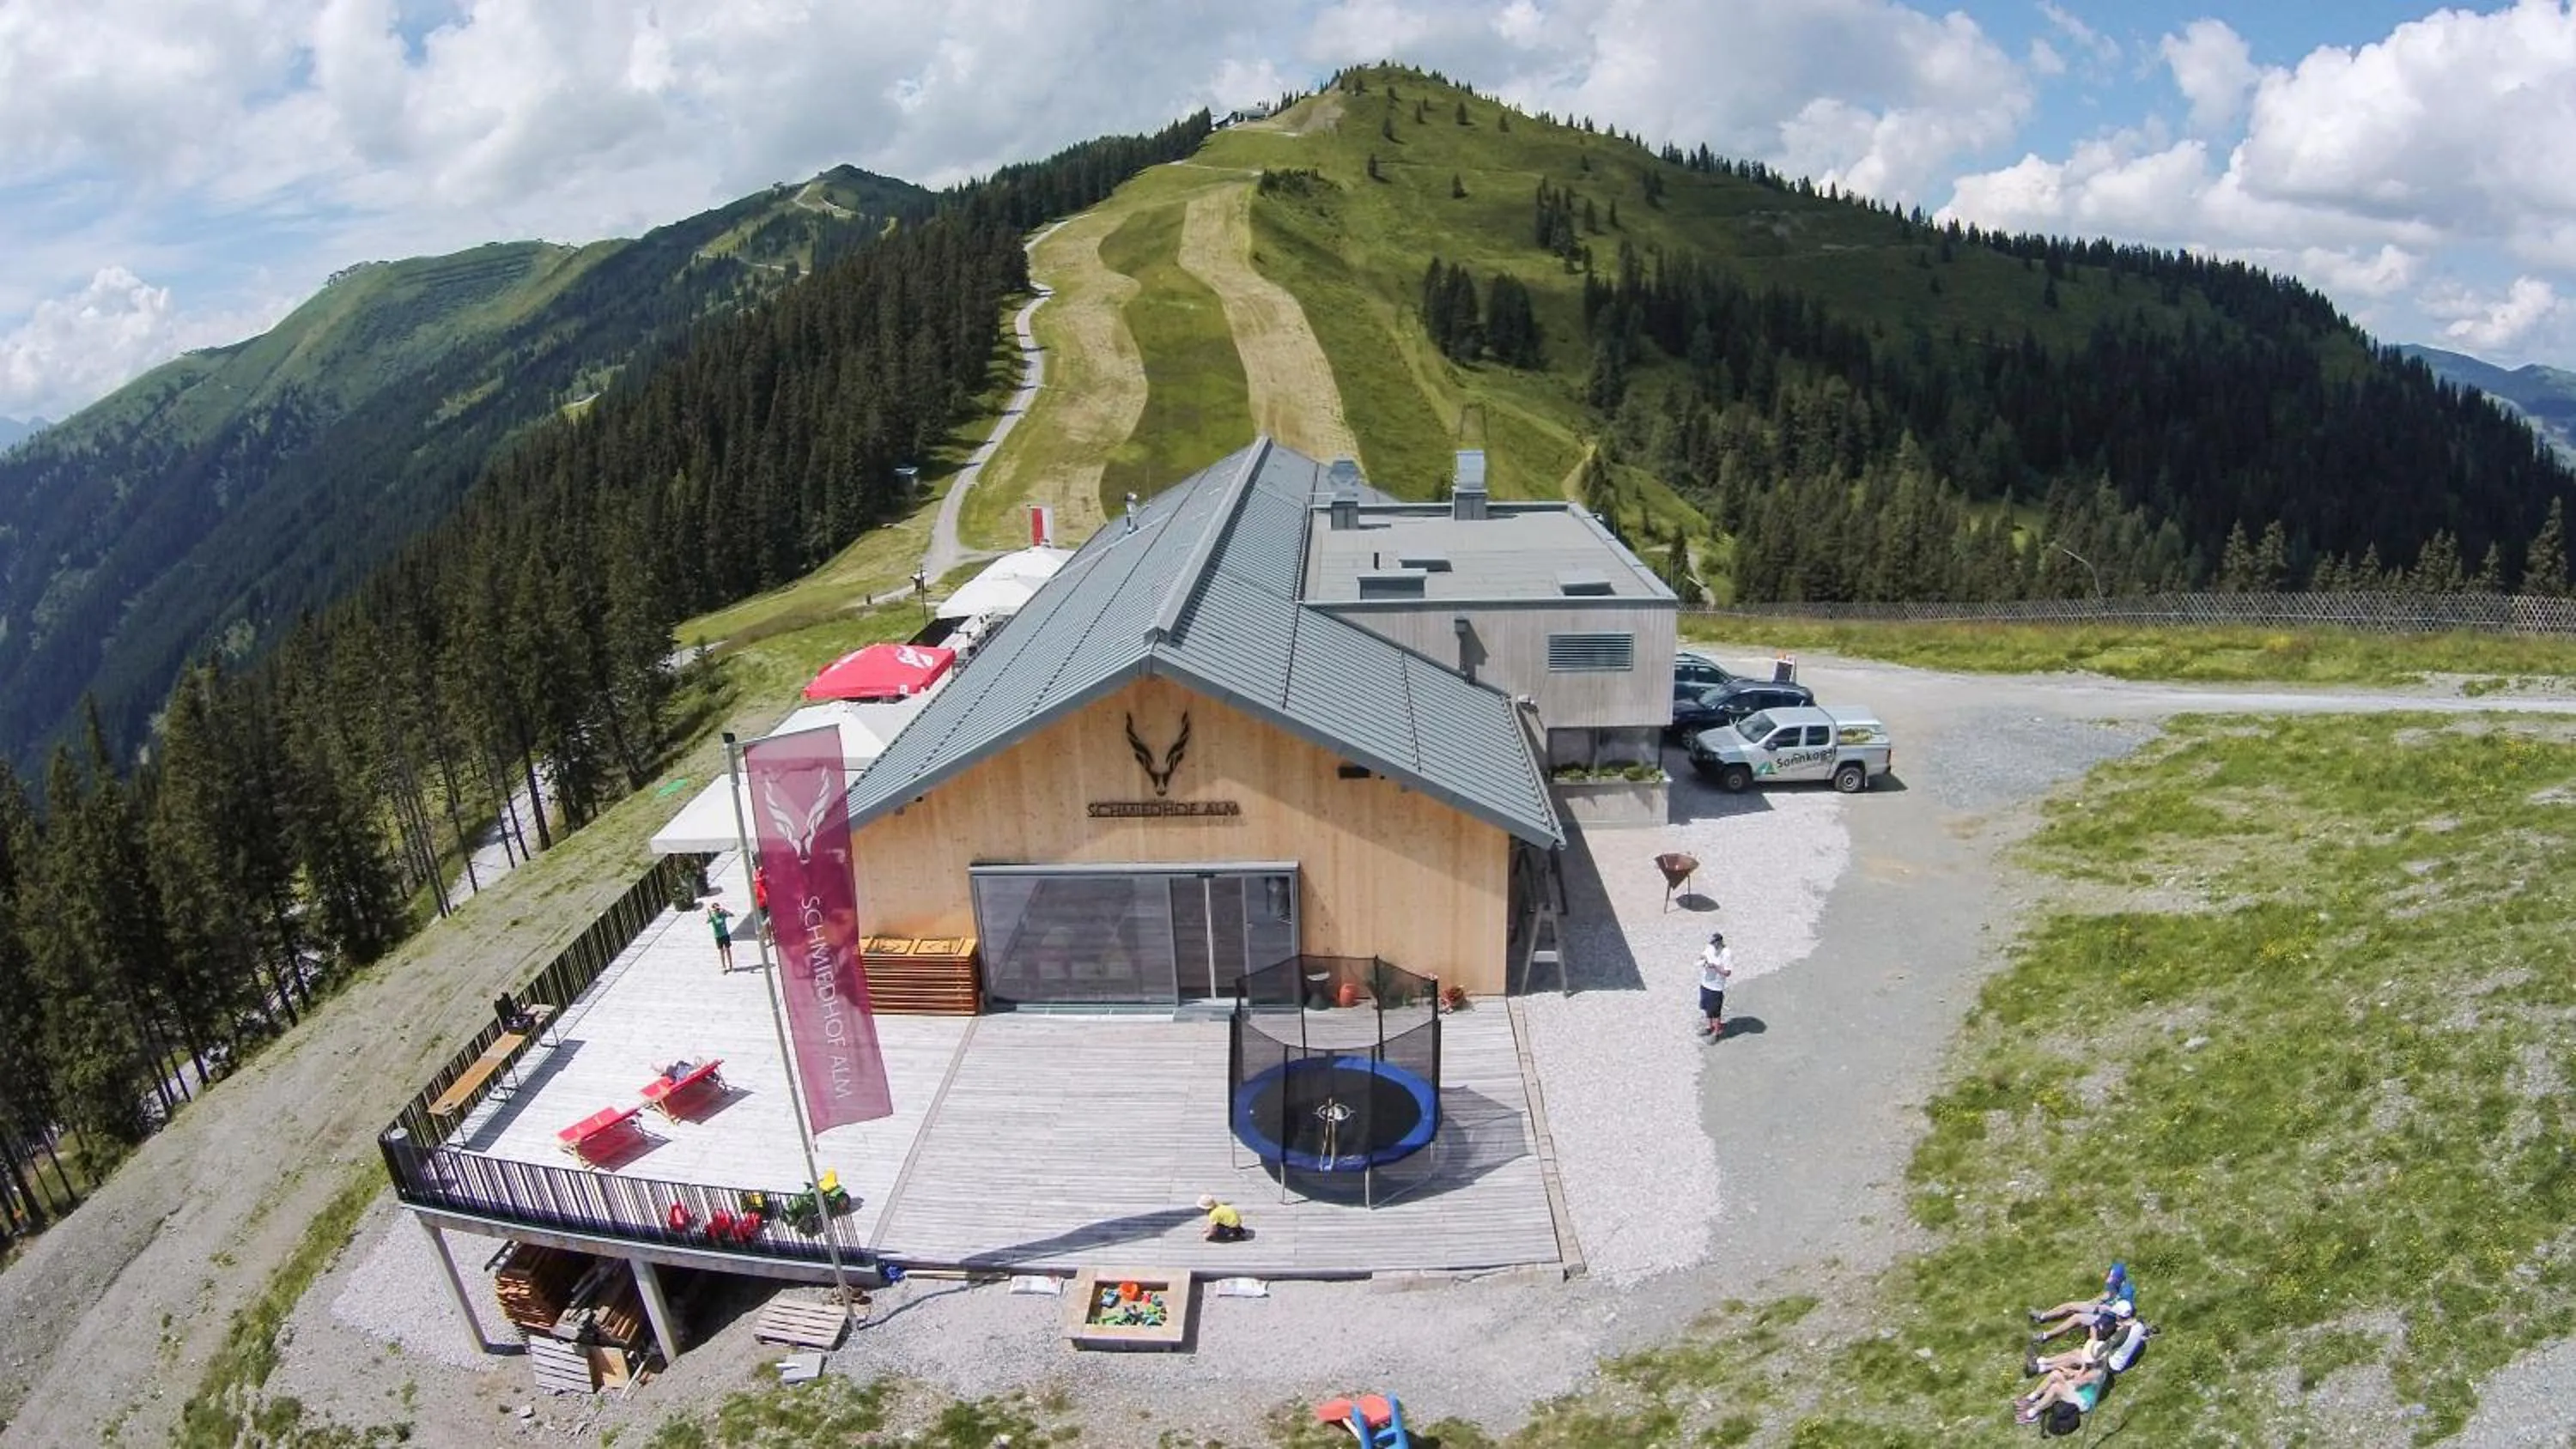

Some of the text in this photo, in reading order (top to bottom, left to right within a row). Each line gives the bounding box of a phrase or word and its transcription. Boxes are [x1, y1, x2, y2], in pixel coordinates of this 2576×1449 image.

[1087, 801, 1241, 817] SCHMIEDHOF ALM
[800, 895, 854, 1099] SCHMIEDHOF ALM
